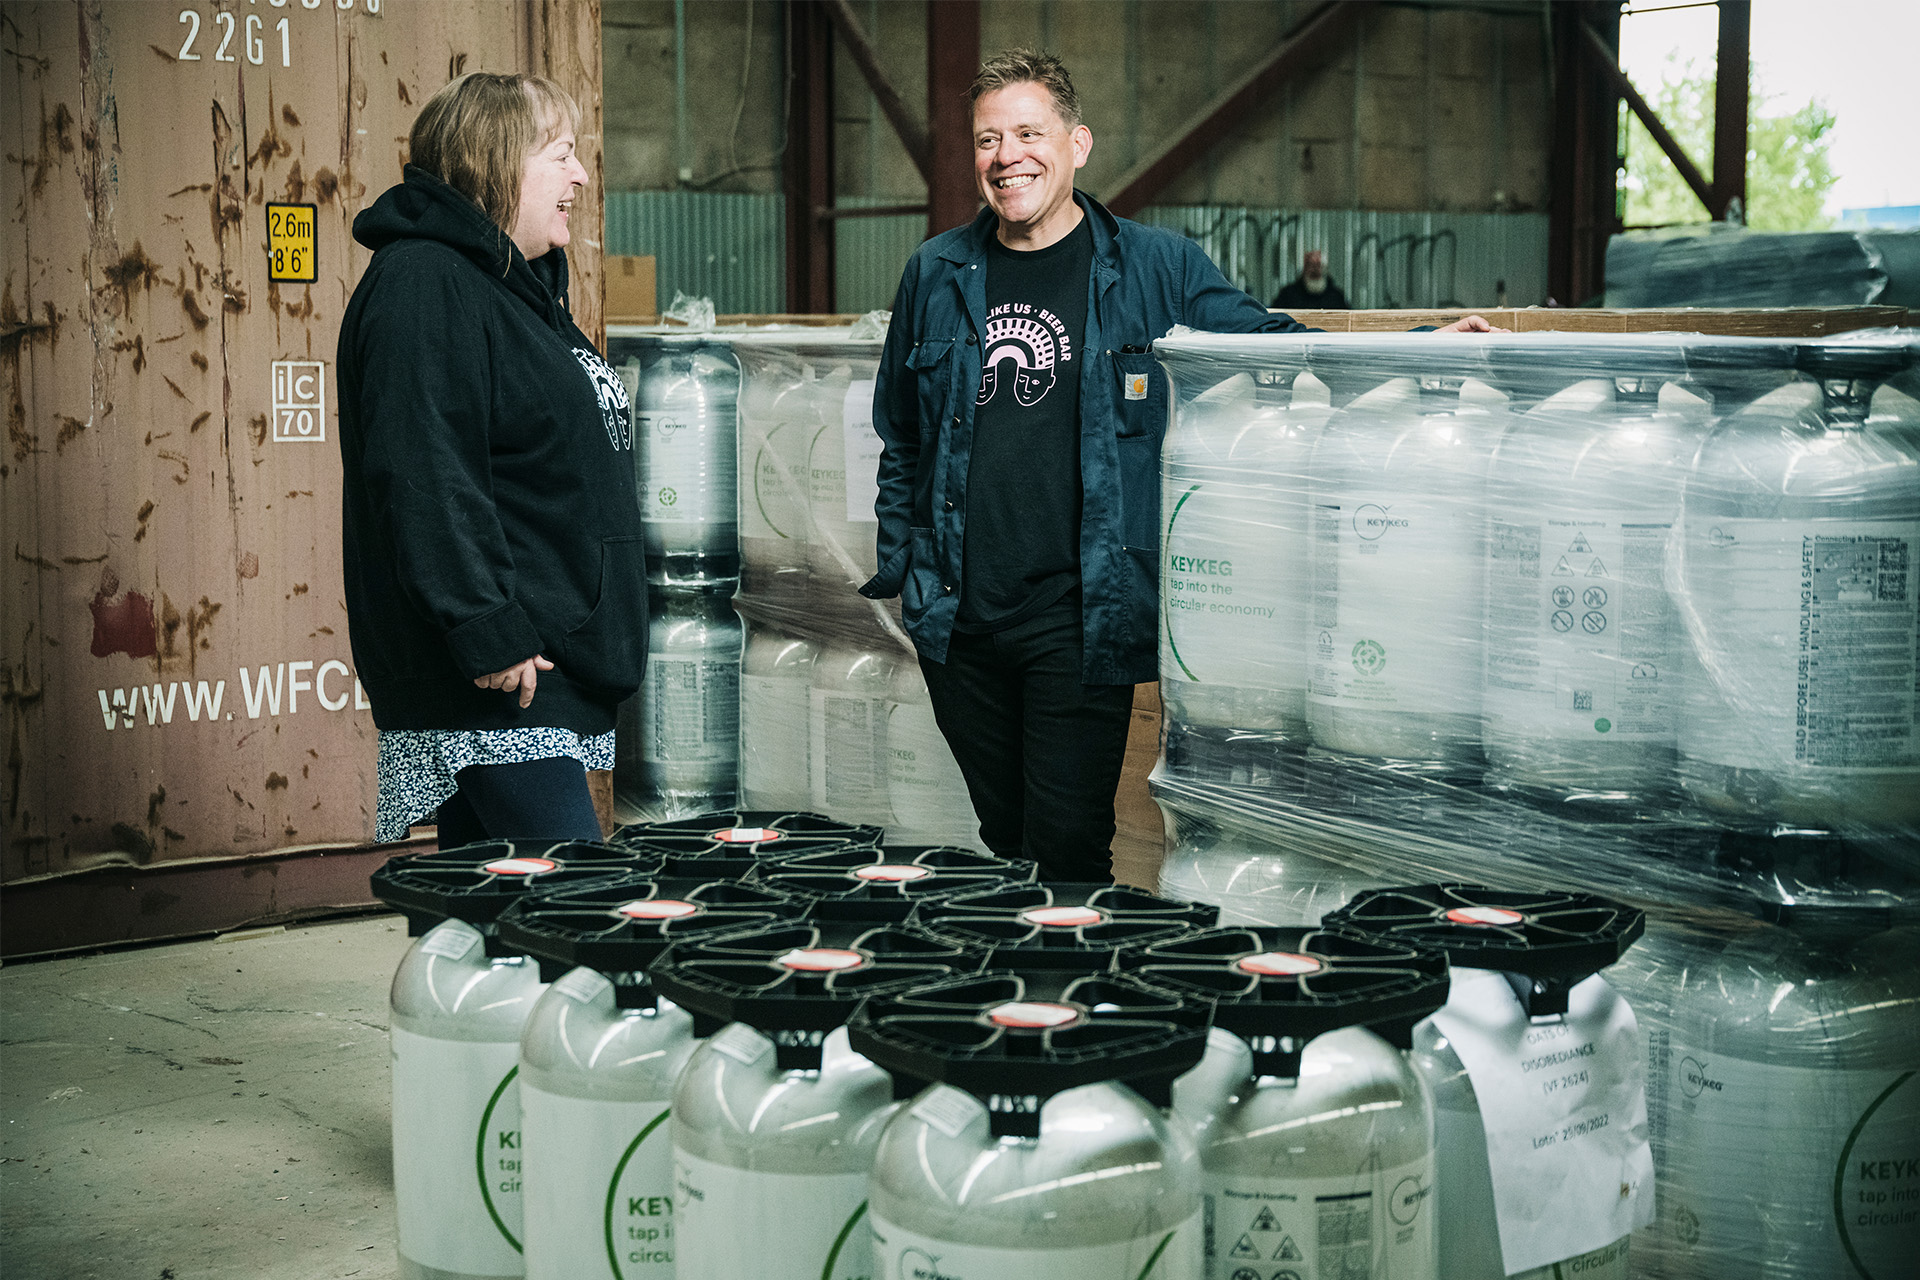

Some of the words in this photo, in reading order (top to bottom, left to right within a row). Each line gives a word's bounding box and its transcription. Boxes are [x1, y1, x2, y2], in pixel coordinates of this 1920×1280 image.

[178, 9, 291, 68] 22G1
[1013, 302, 1032, 315] US
[1038, 308, 1066, 336] BEER
[1058, 335, 1072, 362] BAR
[280, 410, 314, 436] 70
[1171, 555, 1233, 576] KEYKEG
[1802, 535, 1813, 578] SAFETY
[1170, 578, 1185, 592] tap
[1186, 579, 1208, 594] into
[1211, 582, 1233, 596] the
[1170, 595, 1207, 612] circular
[1209, 602, 1276, 619] economy
[1800, 591, 1812, 652] HANDLING
[1797, 682, 1808, 727] BEFORE
[1521, 1042, 1597, 1073] DISOBEDIANCE
[1858, 1188, 1887, 1206] tap
[1892, 1185, 1920, 1202] into
[1858, 1209, 1918, 1226] circular
[628, 1225, 660, 1243] tap
